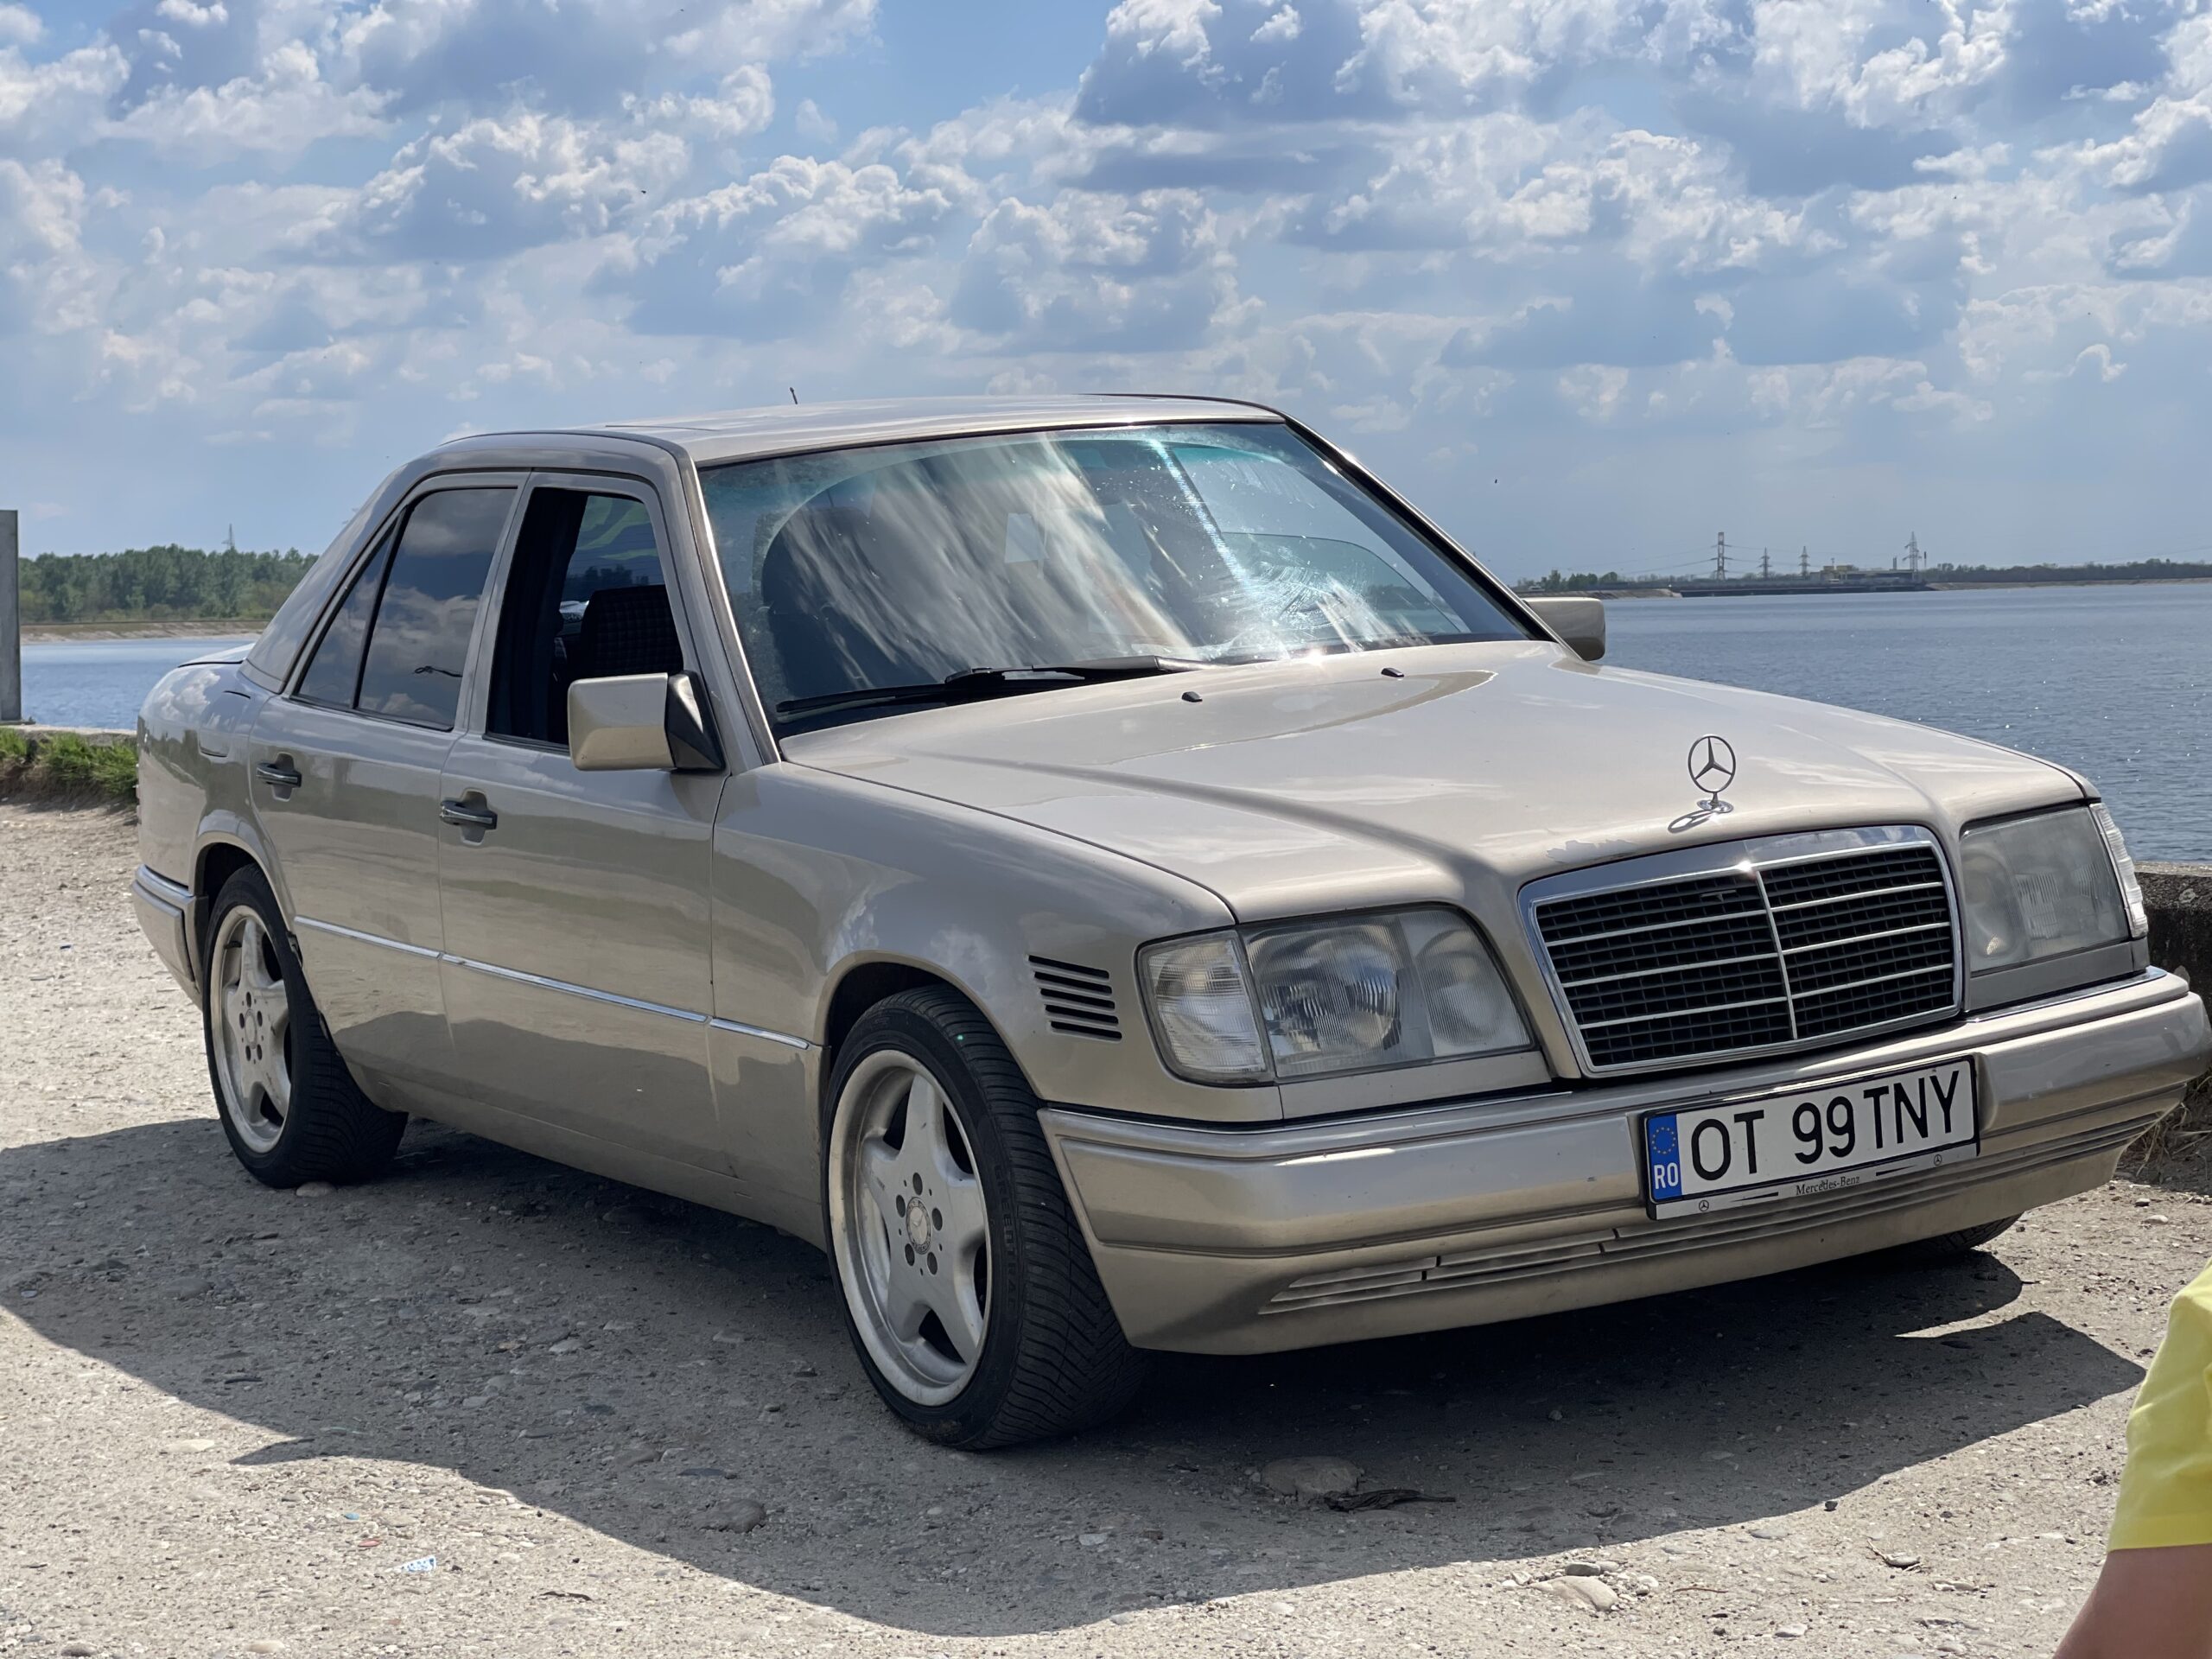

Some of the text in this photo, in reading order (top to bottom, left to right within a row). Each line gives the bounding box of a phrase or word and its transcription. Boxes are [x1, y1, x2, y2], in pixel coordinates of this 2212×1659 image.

[1691, 1070, 1960, 1181] OT 99 TNY
[1654, 1162, 1679, 1190] RO
[1796, 1175, 1860, 1196] Mercedes-Benz
